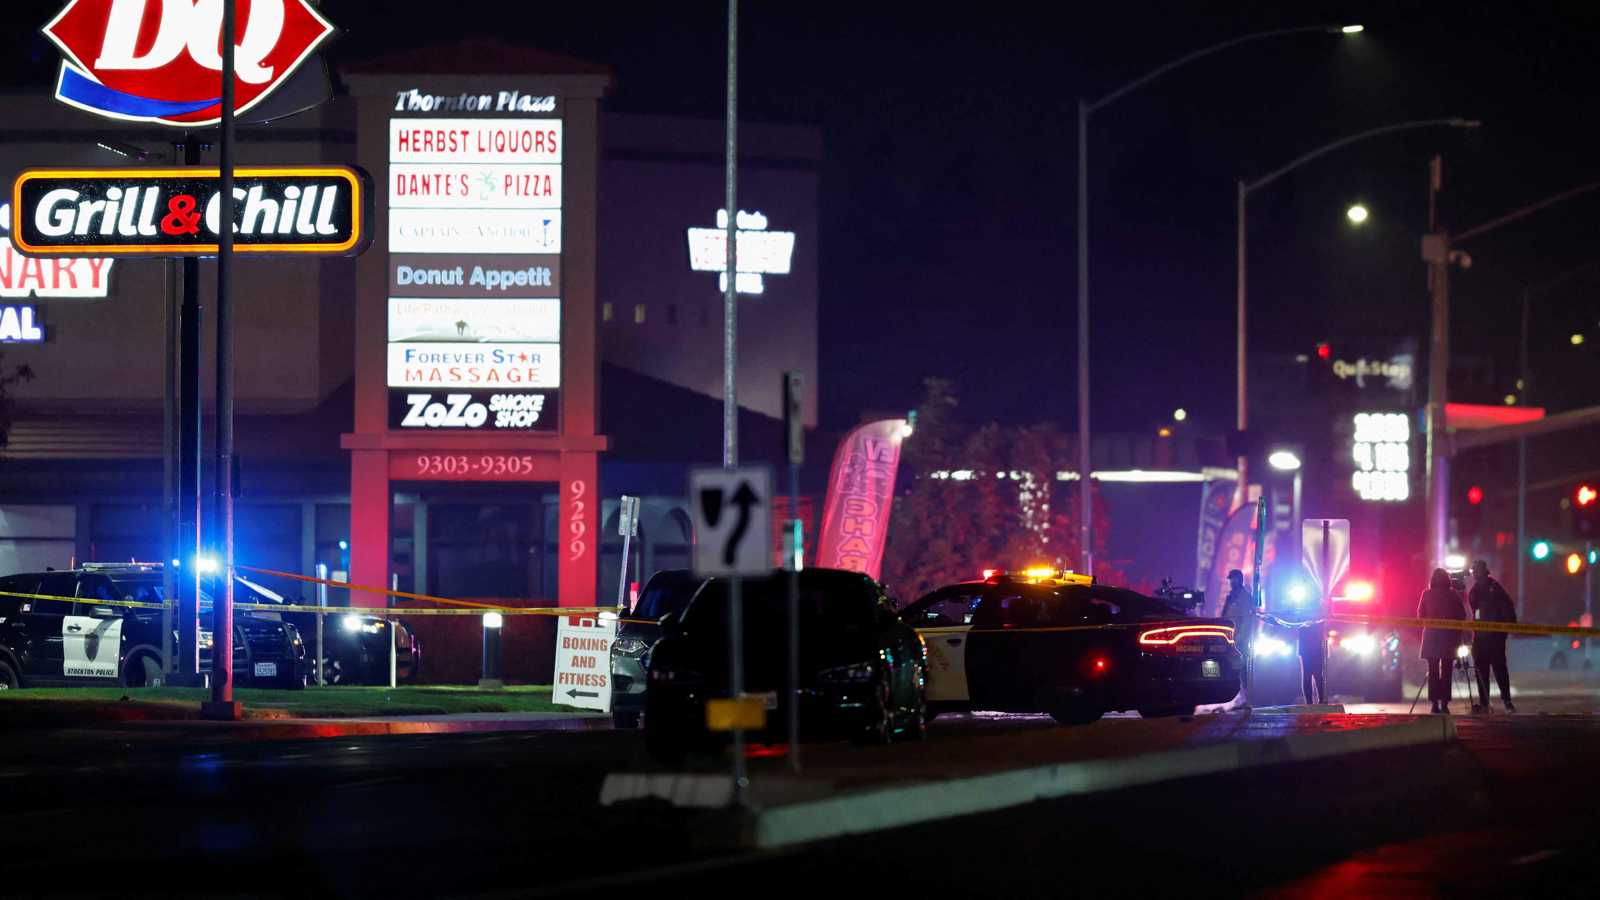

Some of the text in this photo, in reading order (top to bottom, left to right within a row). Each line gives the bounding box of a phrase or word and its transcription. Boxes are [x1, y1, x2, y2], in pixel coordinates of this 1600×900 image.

[394, 88, 556, 112] Thornton Plaza
[398, 129, 558, 154] HERBST LIQUORS
[396, 173, 553, 197] DANTE'S PIZZA
[35, 185, 159, 236] Grill
[205, 184, 338, 236] Chill
[396, 265, 552, 291] Donut Appetit
[404, 367, 541, 383] MASSAGE
[489, 393, 545, 412] SMOKE
[494, 410, 540, 428] SHOP
[417, 455, 534, 475] 9303-9305
[562, 636, 609, 652] BOXING
[570, 655, 597, 669] AND
[558, 672, 608, 688] FITNESS
